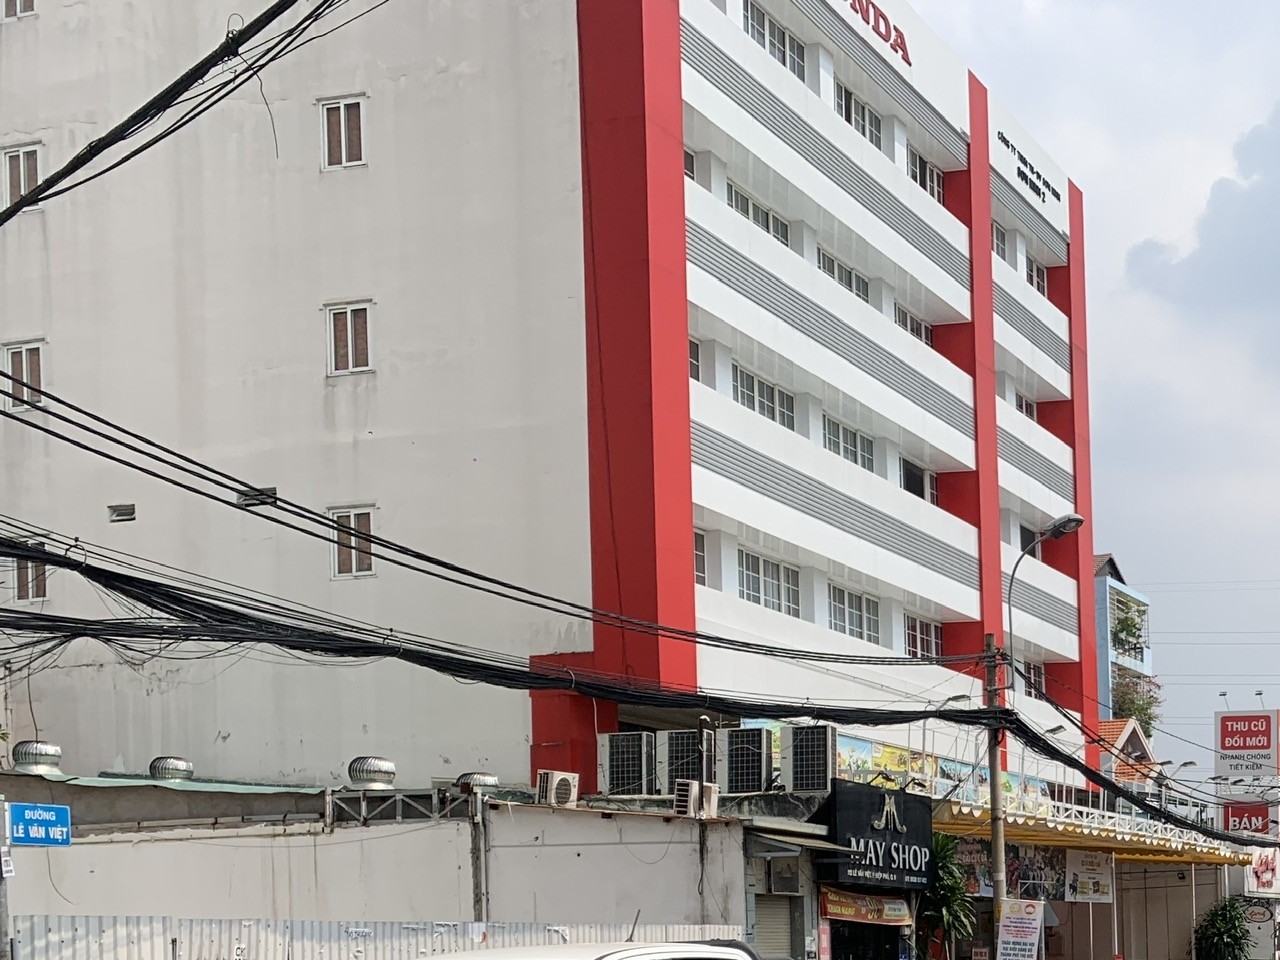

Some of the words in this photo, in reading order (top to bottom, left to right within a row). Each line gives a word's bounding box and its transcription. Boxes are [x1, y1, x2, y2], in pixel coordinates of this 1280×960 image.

[1042, 192, 1046, 203] 2
[1226, 721, 1250, 731] THU
[1251, 719, 1266, 731] CŨ
[1225, 735, 1243, 746] ĐỔI
[1246, 734, 1267, 746] MỚI
[1246, 752, 1271, 760] CHÓNG
[25, 808, 56, 820] ĐƯỜNG
[1230, 814, 1262, 830] BÁN
[13, 822, 25, 837] LÊ
[28, 823, 46, 839] VĂN
[48, 824, 68, 842] VIỆT
[891, 842, 930, 872] SHOP
